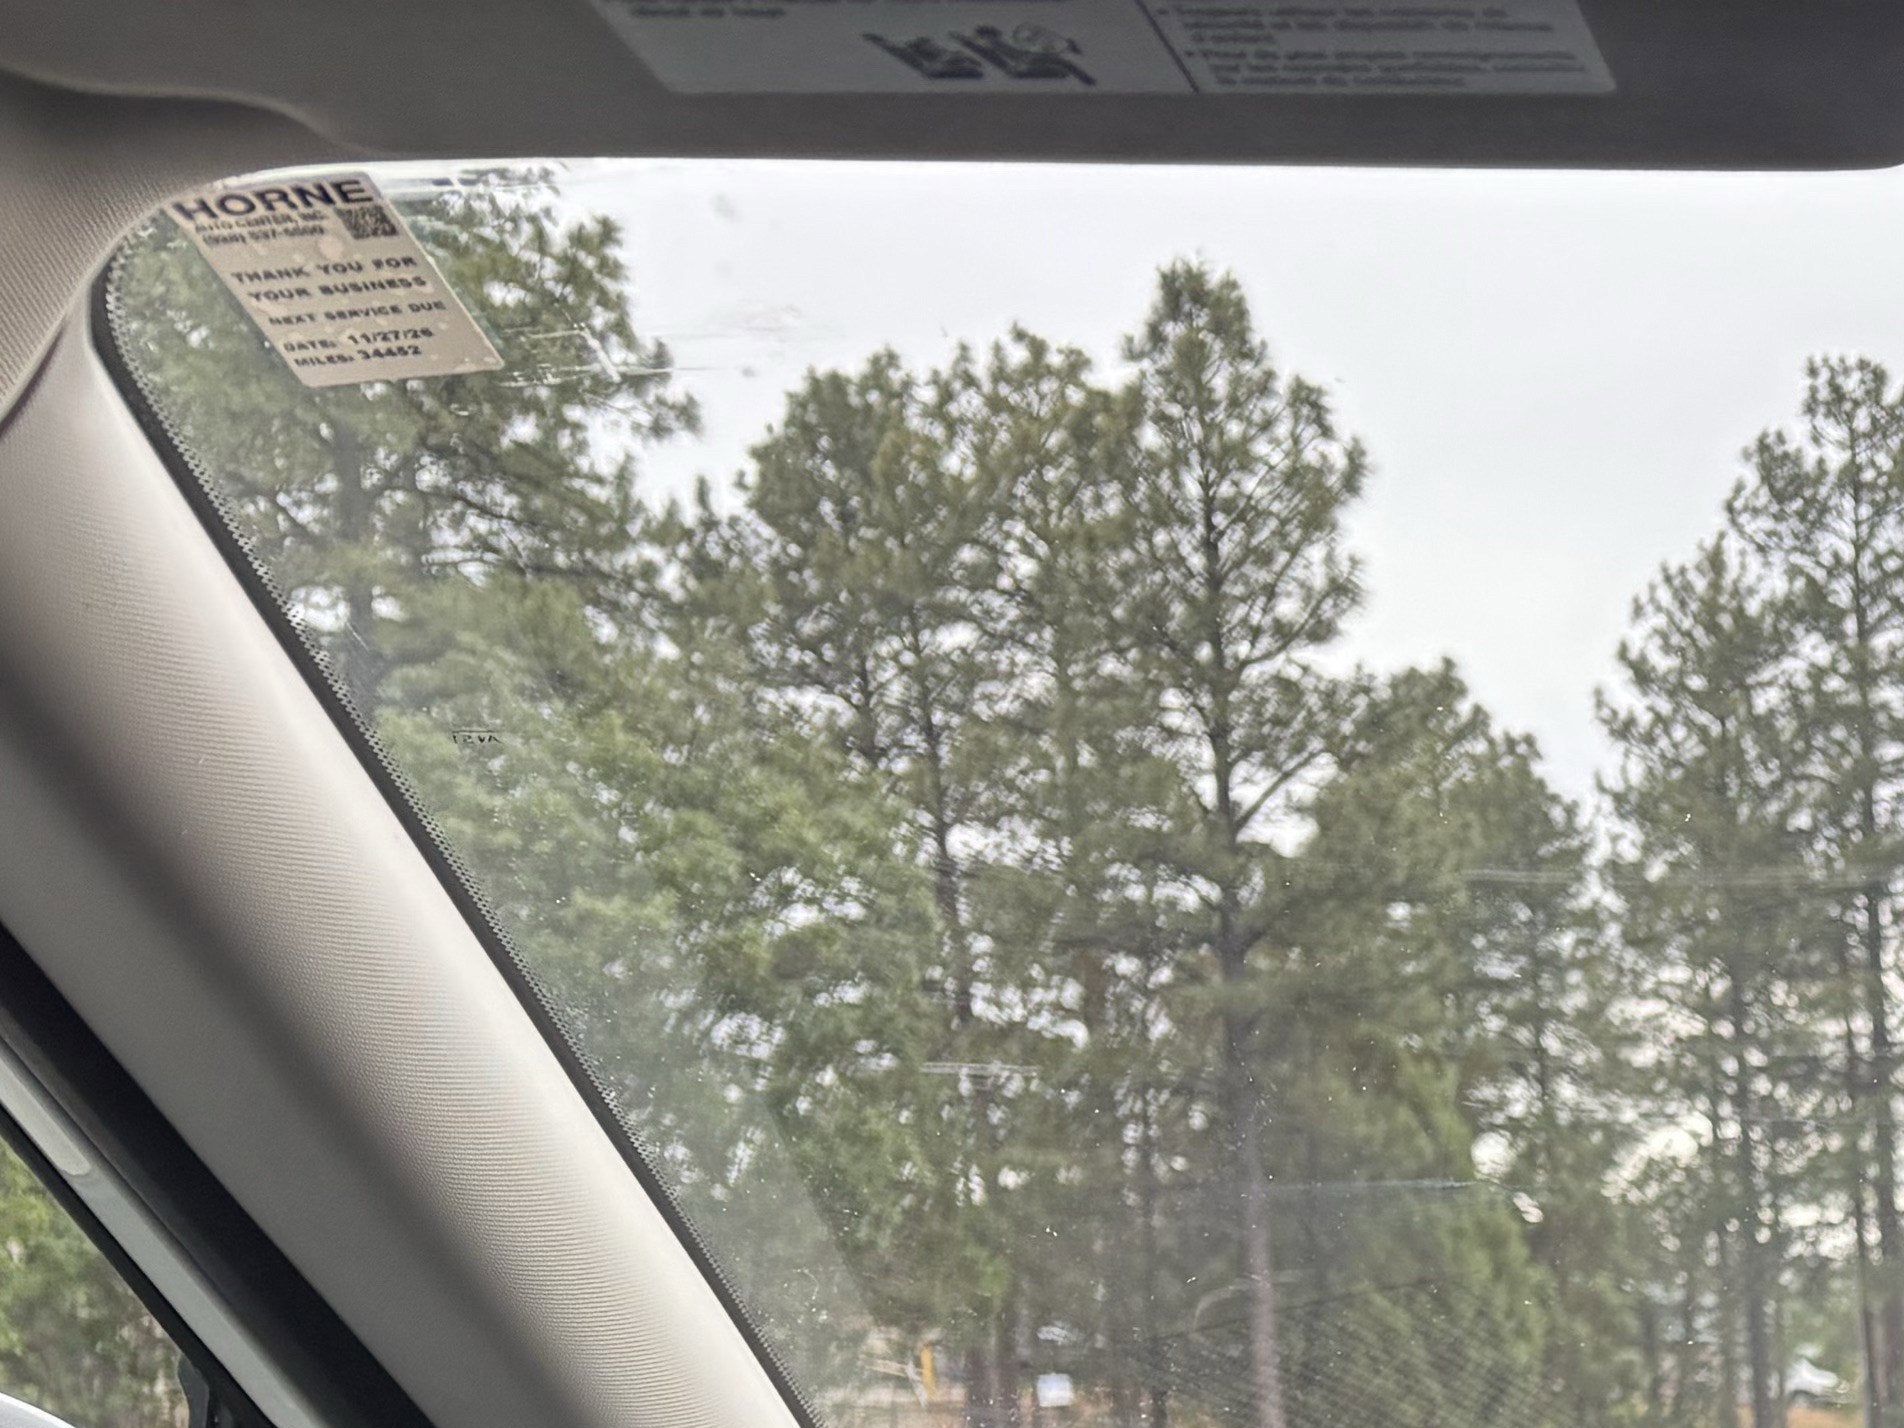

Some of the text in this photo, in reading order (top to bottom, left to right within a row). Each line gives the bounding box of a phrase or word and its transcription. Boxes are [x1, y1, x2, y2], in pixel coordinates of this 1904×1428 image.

[171, 180, 374, 221] HORNE
[231, 256, 418, 285] THANK YOU FOR
[247, 276, 427, 302] YOUR BUSINESS
[268, 300, 446, 326] NEXT SERVICE DUE
